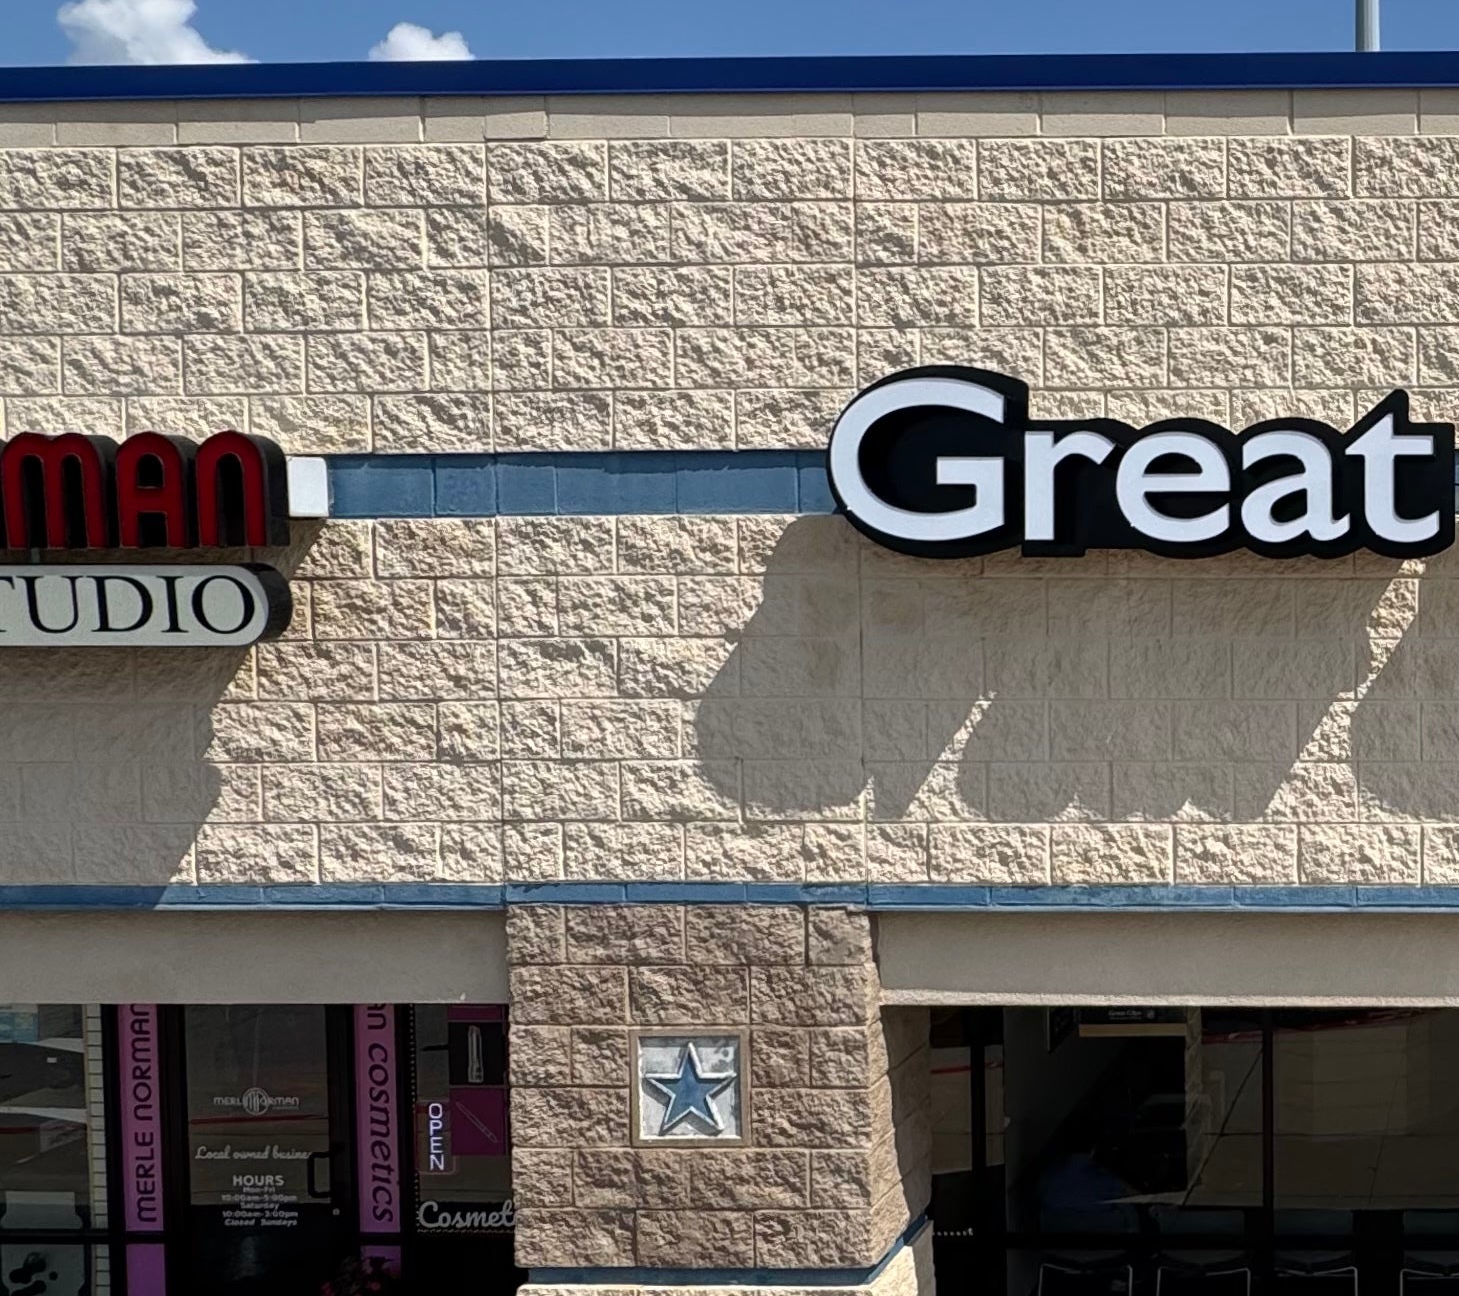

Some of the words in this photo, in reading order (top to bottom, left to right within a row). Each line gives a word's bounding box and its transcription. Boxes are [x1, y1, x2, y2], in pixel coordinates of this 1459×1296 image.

[827, 374, 1440, 548] Great
[194, 1145, 231, 1160] Local
[428, 1102, 445, 1171] OPEN
[135, 1131, 157, 1223] MERLE
[233, 1174, 286, 1187] HOURS
[419, 1200, 515, 1228] Cosmet
